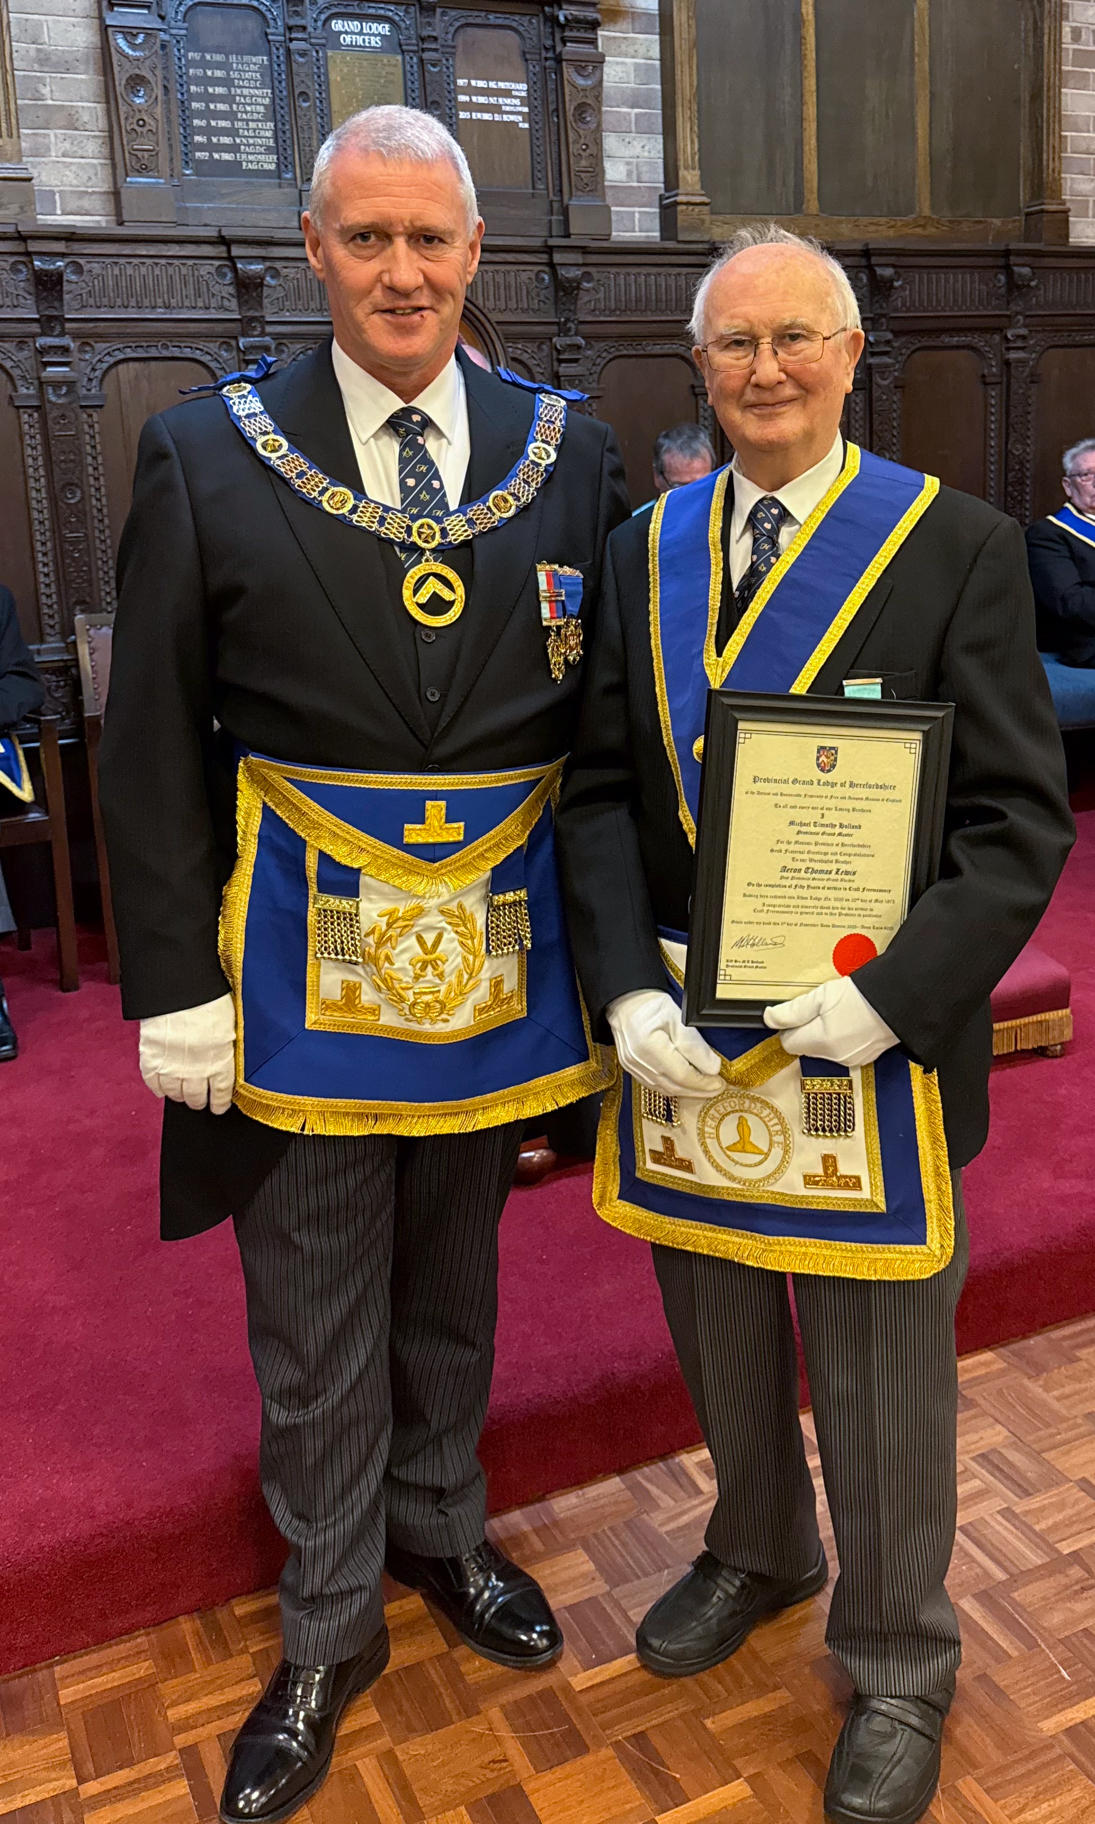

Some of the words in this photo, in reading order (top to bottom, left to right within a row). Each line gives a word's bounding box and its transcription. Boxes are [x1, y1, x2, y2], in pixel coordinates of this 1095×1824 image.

[331, 20, 361, 33] GRAND
[362, 22, 391, 35] LODGE
[340, 34, 382, 47] OFFICERS
[752, 775, 790, 785] Provincial
[791, 778, 814, 787] Grand
[816, 778, 838, 788] Lodge
[840, 780, 847, 788] of
[848, 780, 897, 791] Herefordshire
[788, 820, 812, 828] Michael
[813, 821, 838, 830] Timothy
[804, 866, 834, 875] Thomas
[834, 868, 858, 876] Lewis
[704, 1099, 784, 1151] HEREFORDSHIRE
